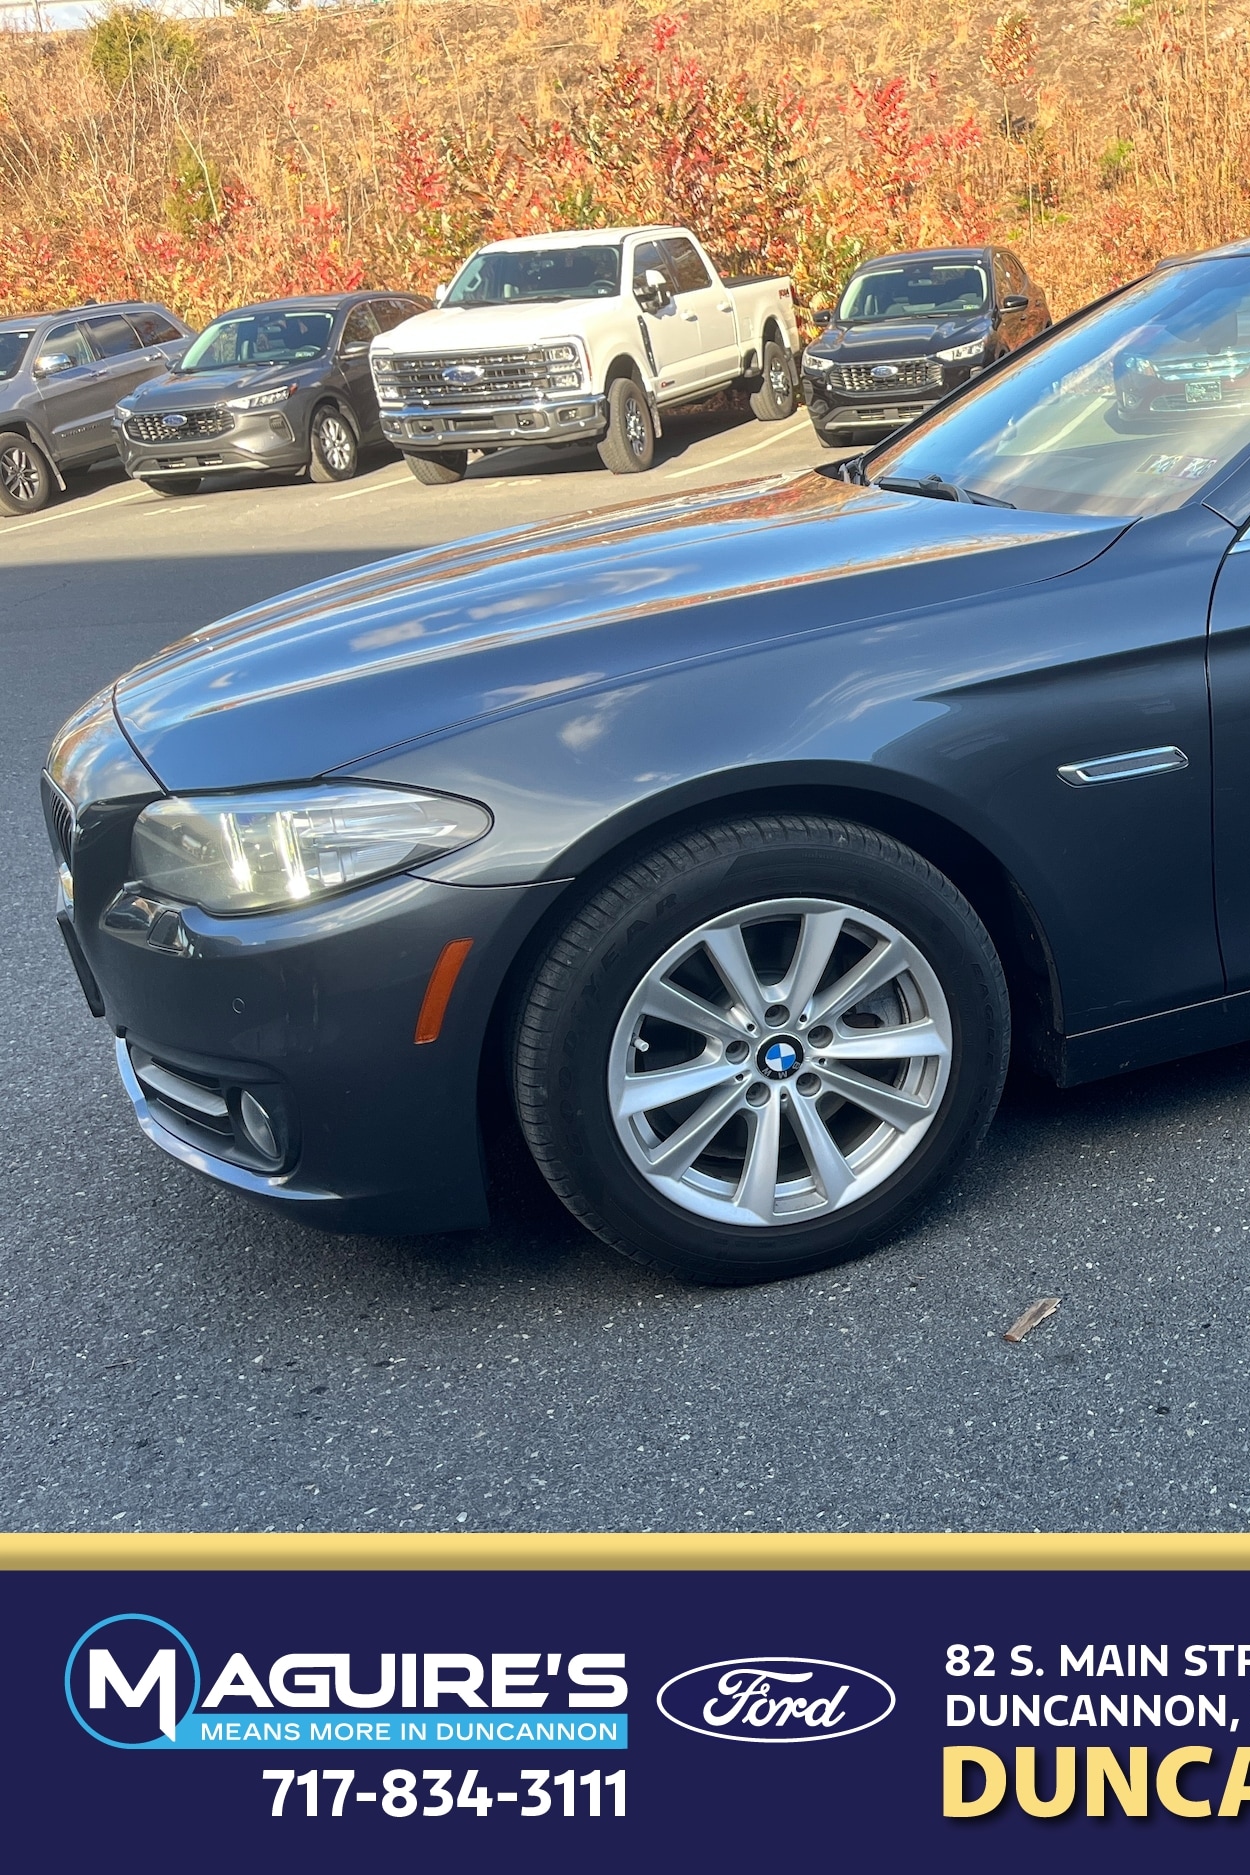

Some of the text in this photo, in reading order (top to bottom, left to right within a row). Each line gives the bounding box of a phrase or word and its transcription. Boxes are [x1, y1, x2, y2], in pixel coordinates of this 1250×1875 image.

[558, 892, 678, 1158] GOODYEAR
[970, 962, 997, 1068] EAGLE
[762, 1061, 801, 1079] BMW
